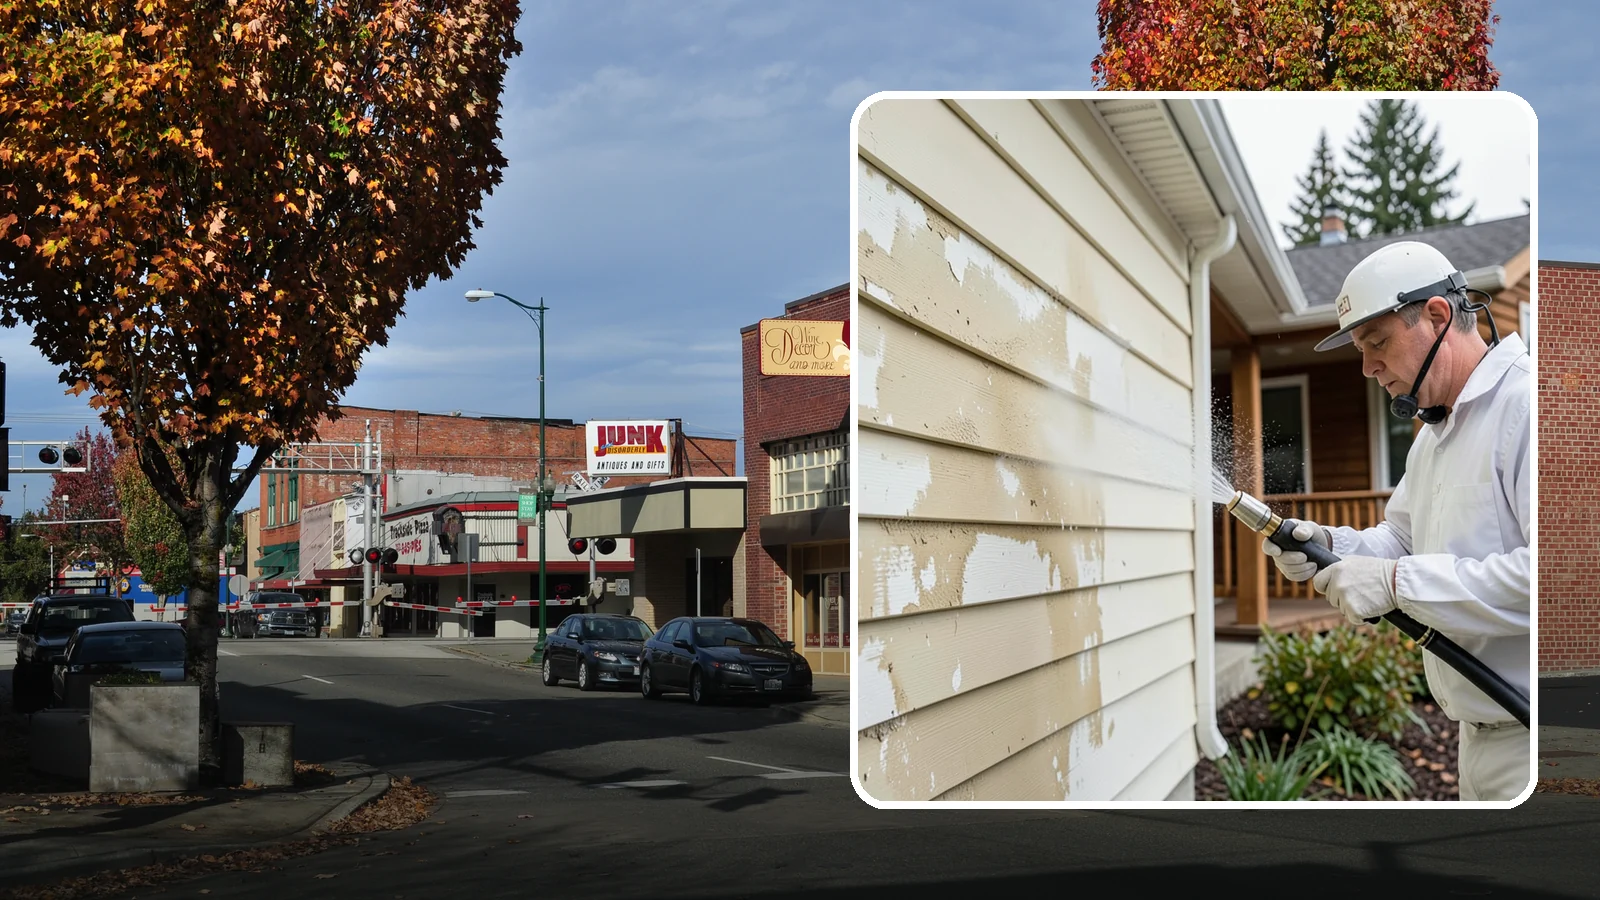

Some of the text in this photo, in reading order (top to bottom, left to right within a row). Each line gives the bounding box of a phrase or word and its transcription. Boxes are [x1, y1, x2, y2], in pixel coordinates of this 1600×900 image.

[595, 425, 665, 457] JUNK
[607, 446, 646, 454] DISORDERLY
[597, 460, 665, 470] ANTIQUES AND GIFTS
[414, 519, 429, 535] Pizza
